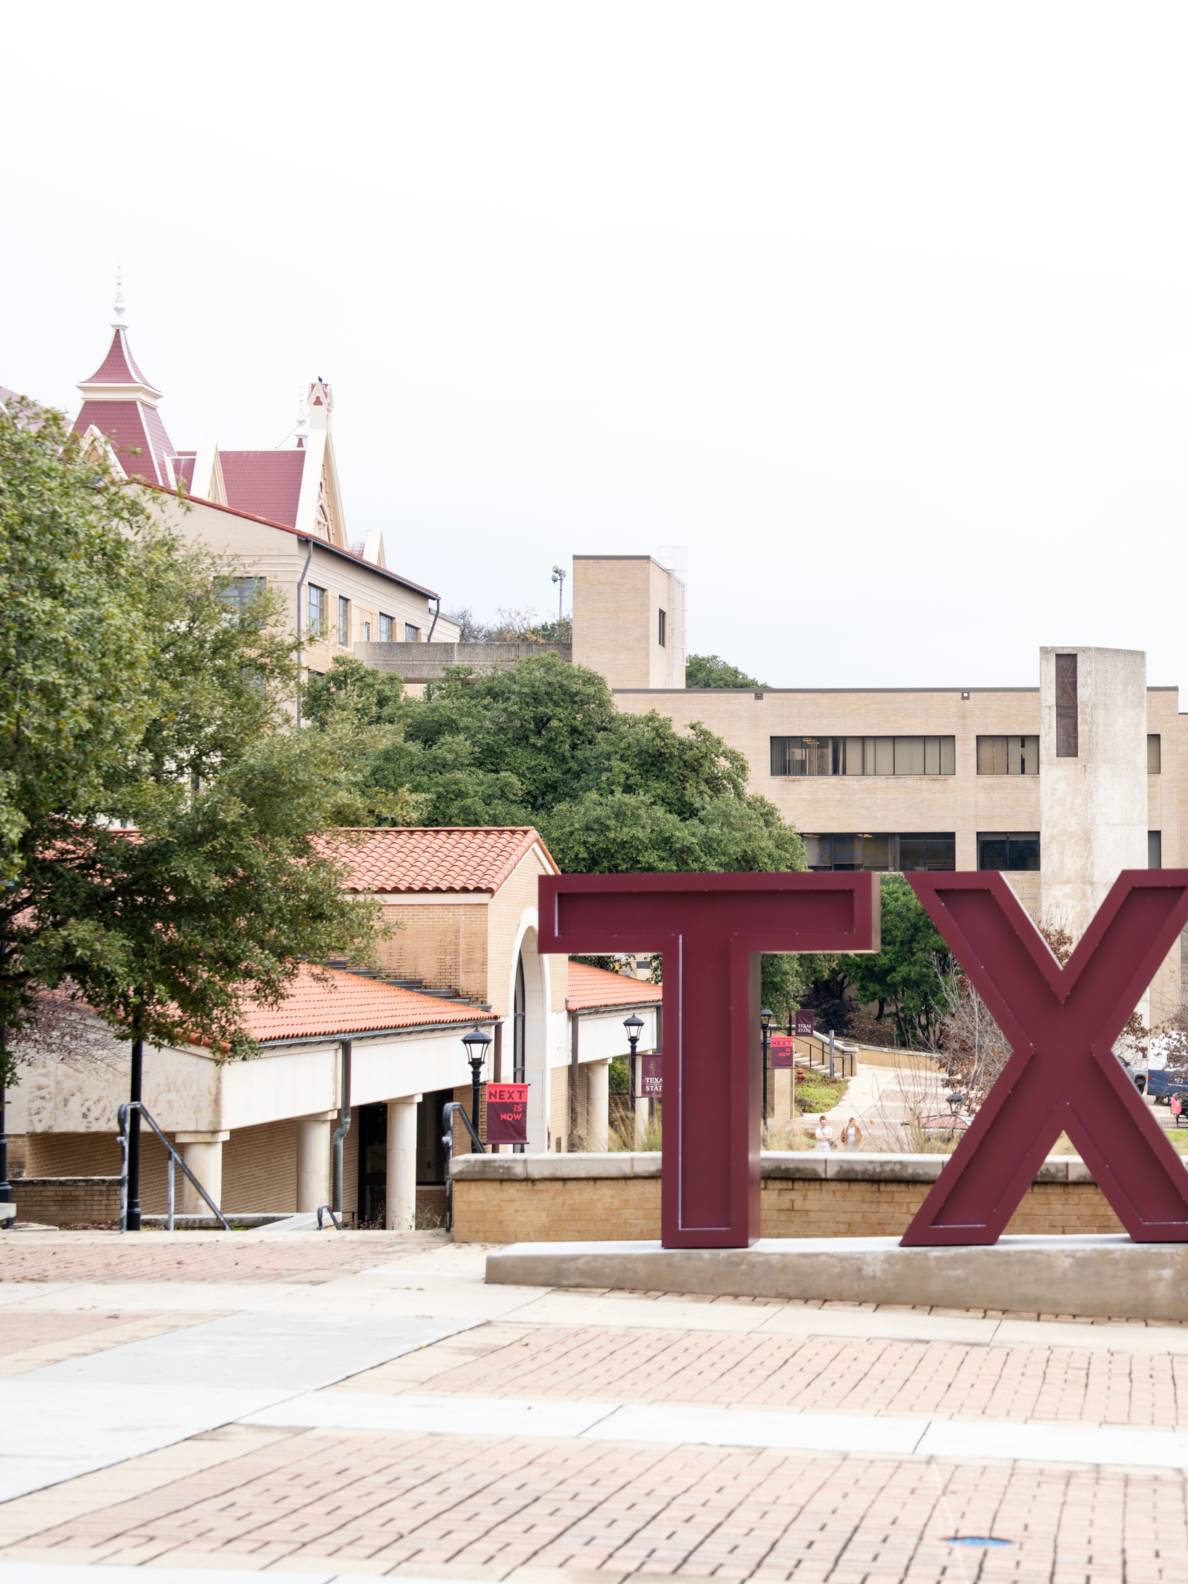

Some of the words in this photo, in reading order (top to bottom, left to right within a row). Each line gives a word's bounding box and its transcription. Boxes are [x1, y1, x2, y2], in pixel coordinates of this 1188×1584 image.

[489, 1090, 525, 1100] NEXT
[513, 1104, 523, 1112] IS
[500, 1112, 522, 1121] NOW
